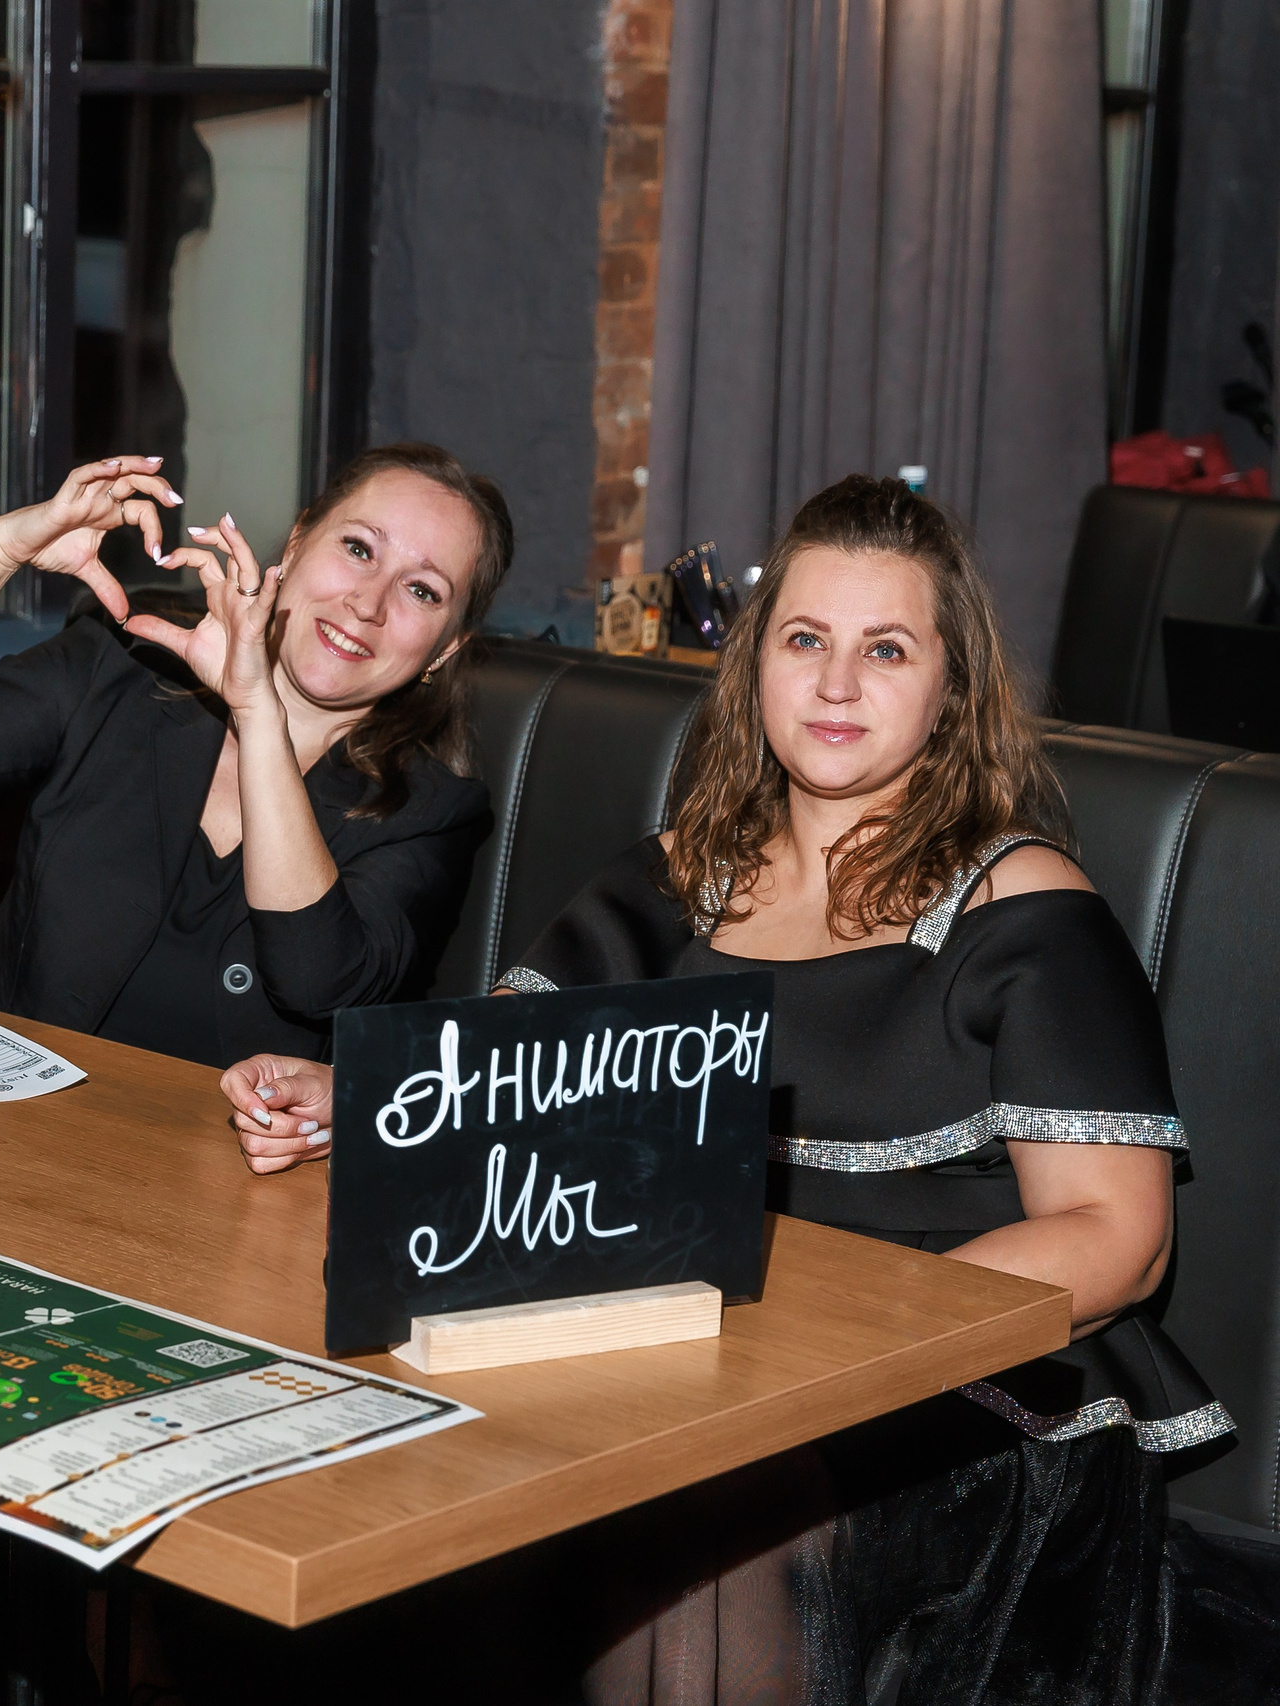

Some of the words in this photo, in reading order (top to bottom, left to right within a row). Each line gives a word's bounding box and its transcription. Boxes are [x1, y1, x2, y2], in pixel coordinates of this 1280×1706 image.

[375, 1009, 770, 1148] Аниматоры
[408, 1143, 638, 1277] Мы
[1, 1353, 39, 1370] 13
